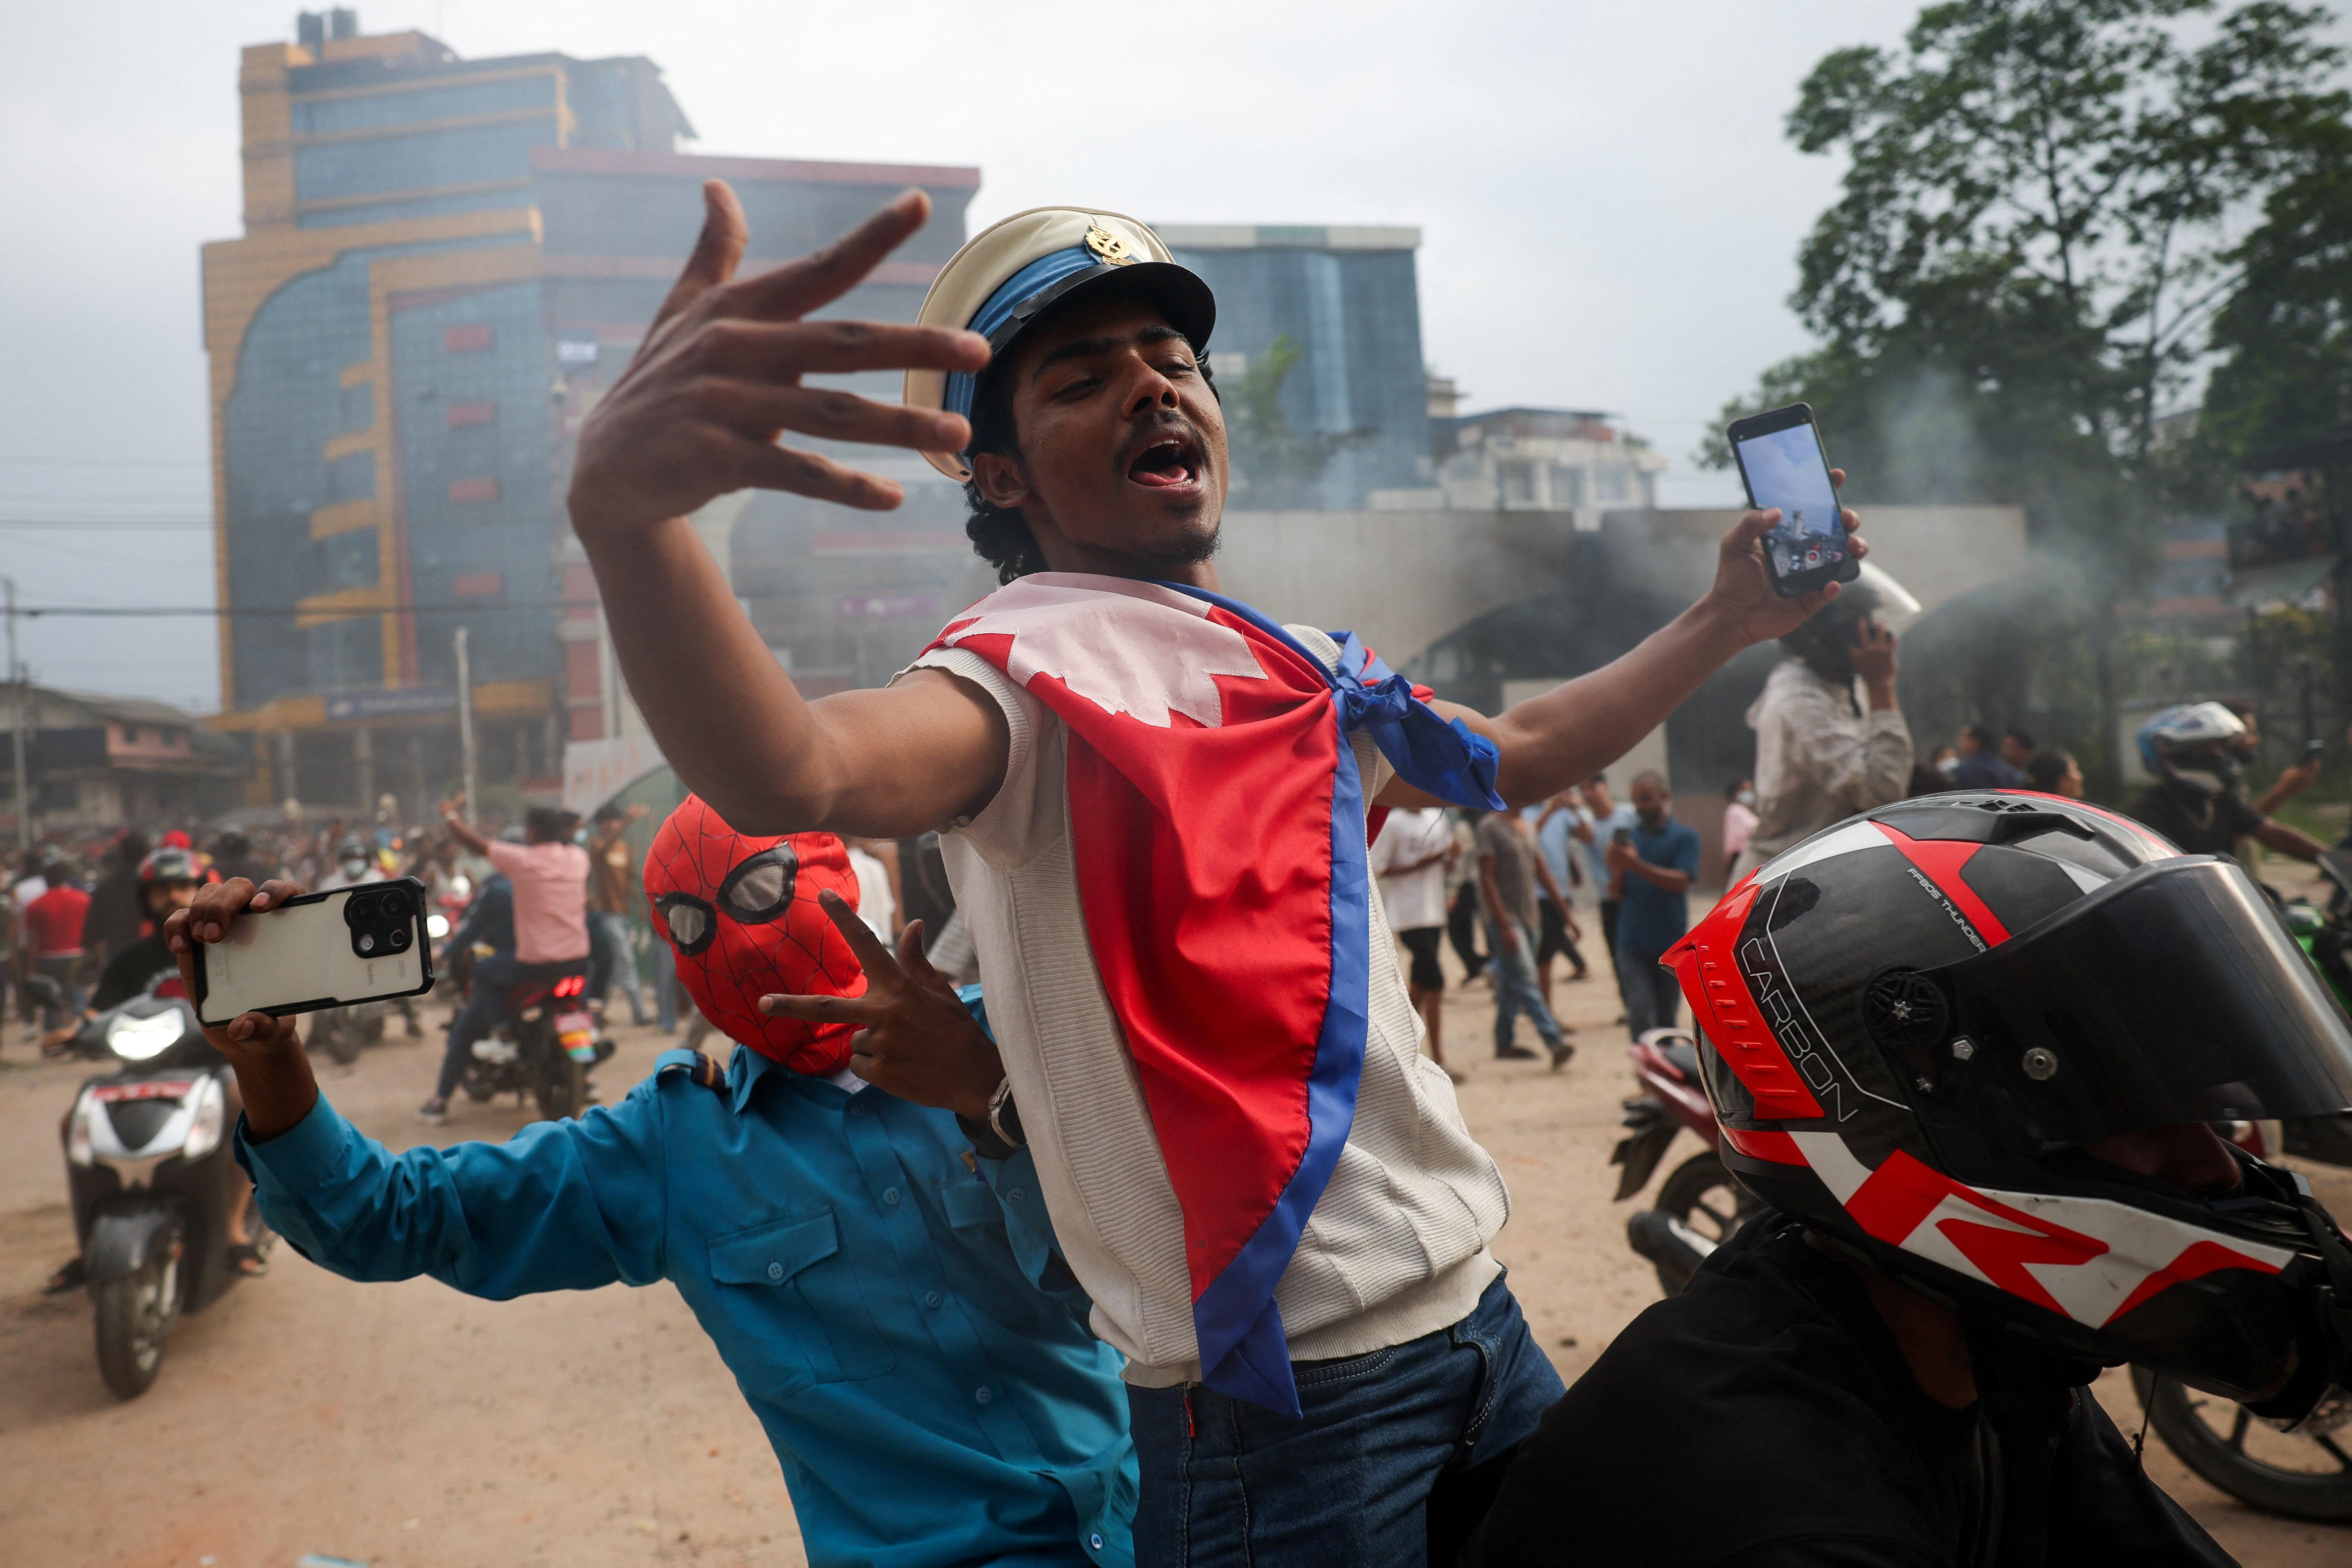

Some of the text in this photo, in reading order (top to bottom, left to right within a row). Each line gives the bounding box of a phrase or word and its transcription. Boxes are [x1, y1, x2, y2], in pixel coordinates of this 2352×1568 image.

[1906, 868, 1987, 954] FF805 THUNDER
[366, 963, 375, 985] Redmi
[1741, 938, 1859, 1122] CARBON
